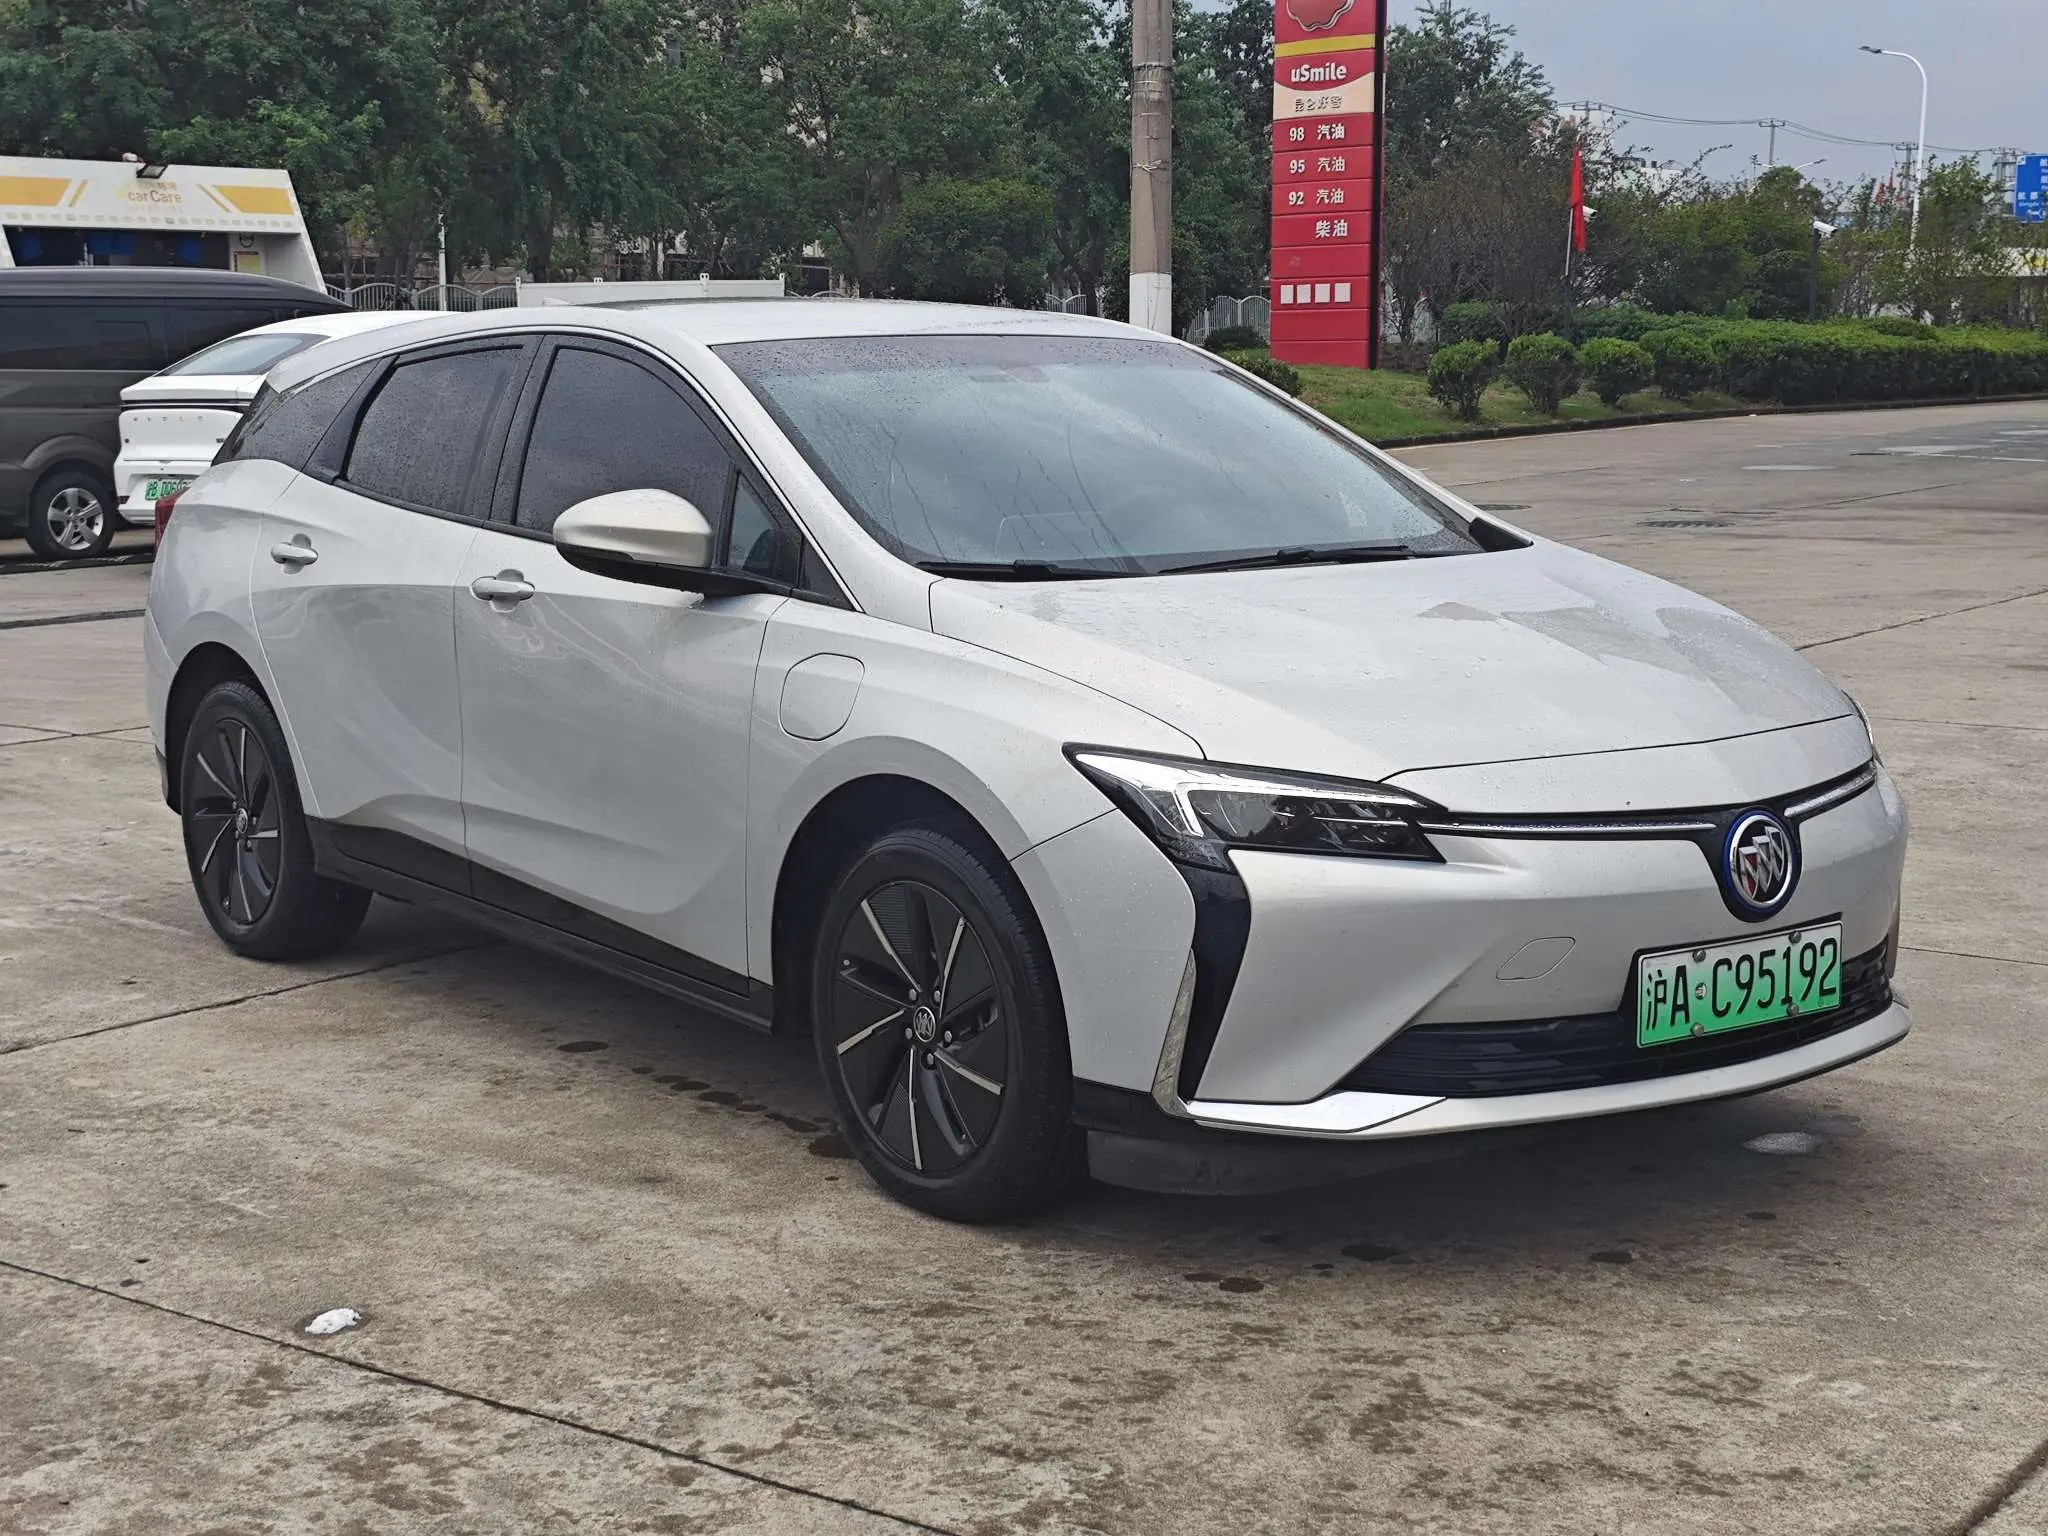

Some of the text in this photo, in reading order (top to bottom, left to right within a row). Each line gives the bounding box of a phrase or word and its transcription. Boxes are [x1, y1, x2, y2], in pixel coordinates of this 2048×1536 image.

[1291, 62, 1347, 83] uSmile
[1289, 123, 1345, 142] 98 汽油
[1289, 156, 1345, 174] 95 汽油
[1288, 188, 1344, 205] 92 汽油
[1315, 219, 1348, 238] 柴油
